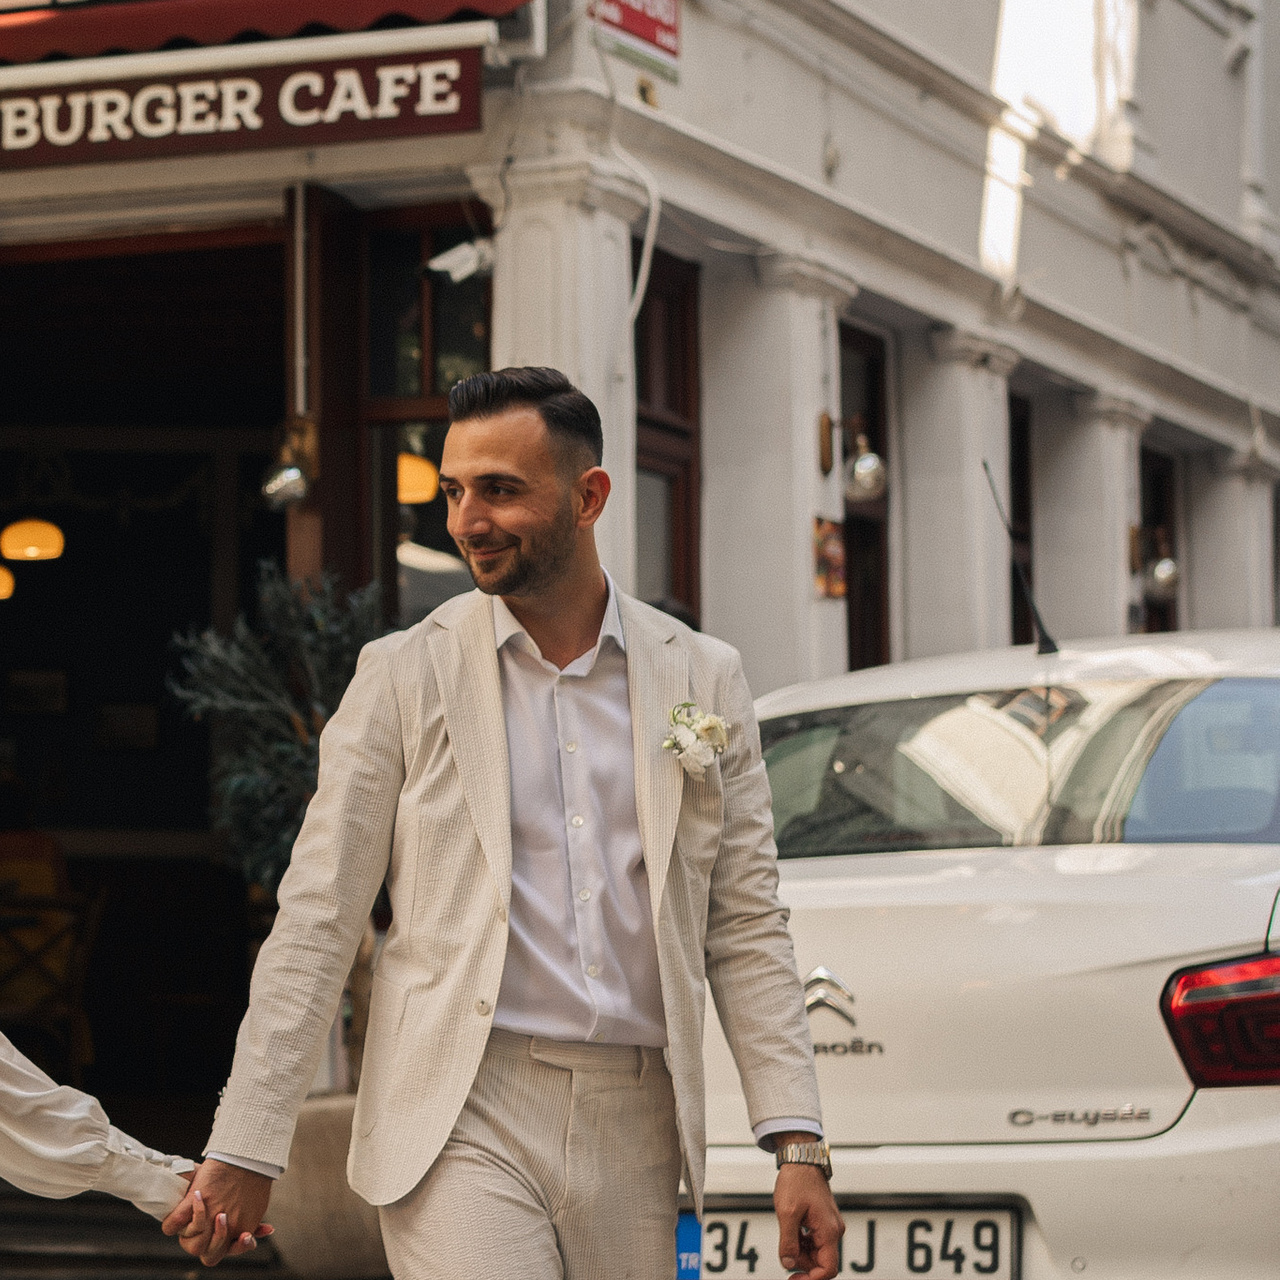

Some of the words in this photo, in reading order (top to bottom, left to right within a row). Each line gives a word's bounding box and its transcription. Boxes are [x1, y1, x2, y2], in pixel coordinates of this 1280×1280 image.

[0, 77, 264, 152] BURGER
[277, 58, 462, 126] CAFE
[679, 1252, 700, 1270] TR
[705, 1219, 760, 1273] 34
[906, 1219, 1001, 1274] 649
